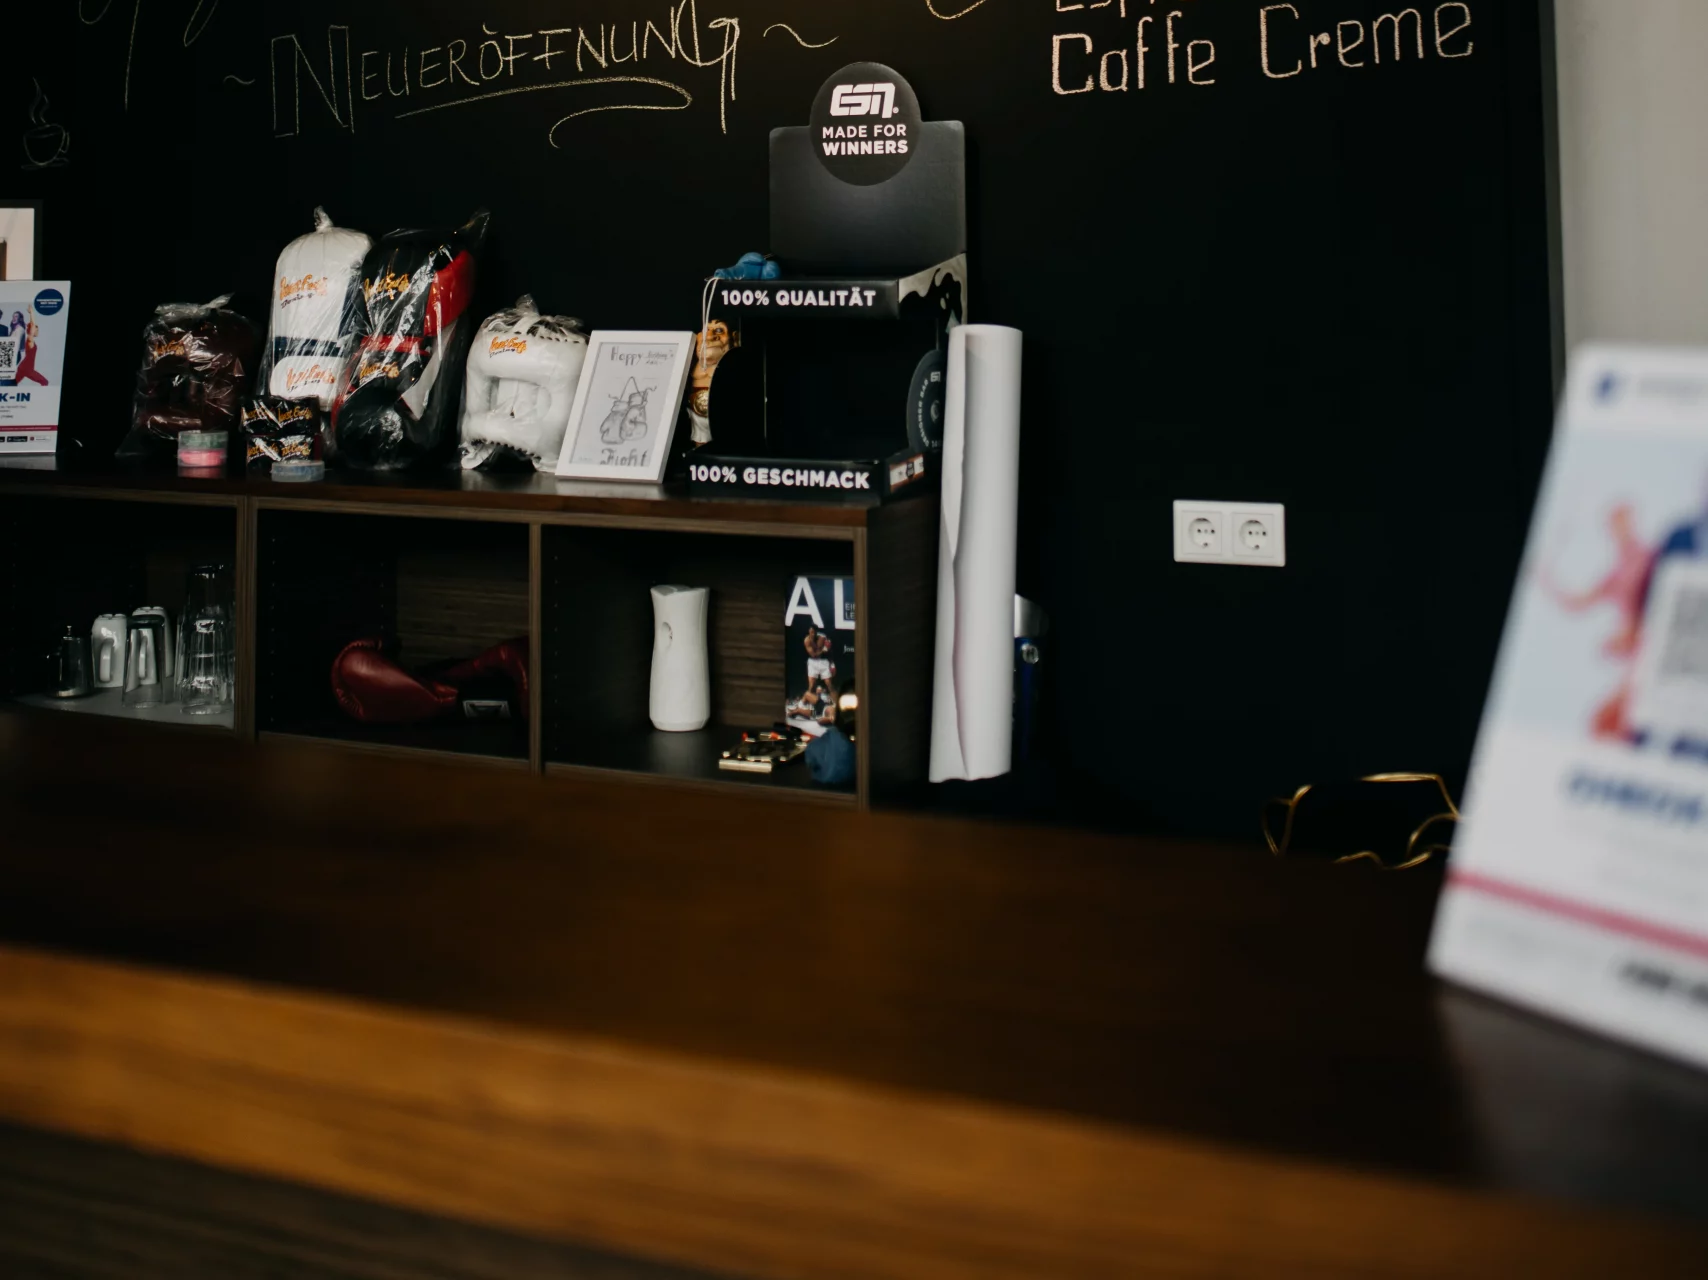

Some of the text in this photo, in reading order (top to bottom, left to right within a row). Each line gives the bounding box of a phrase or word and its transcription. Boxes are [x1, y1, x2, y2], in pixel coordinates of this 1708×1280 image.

[1052, 2, 1474, 95] Caffe Creme
[822, 123, 907, 139] MADE FOR
[822, 139, 909, 156] WINNERS
[721, 286, 877, 307] 100% QUALITÄT
[611, 346, 643, 366] Happy
[689, 464, 870, 489] 100% GESCHMACK
